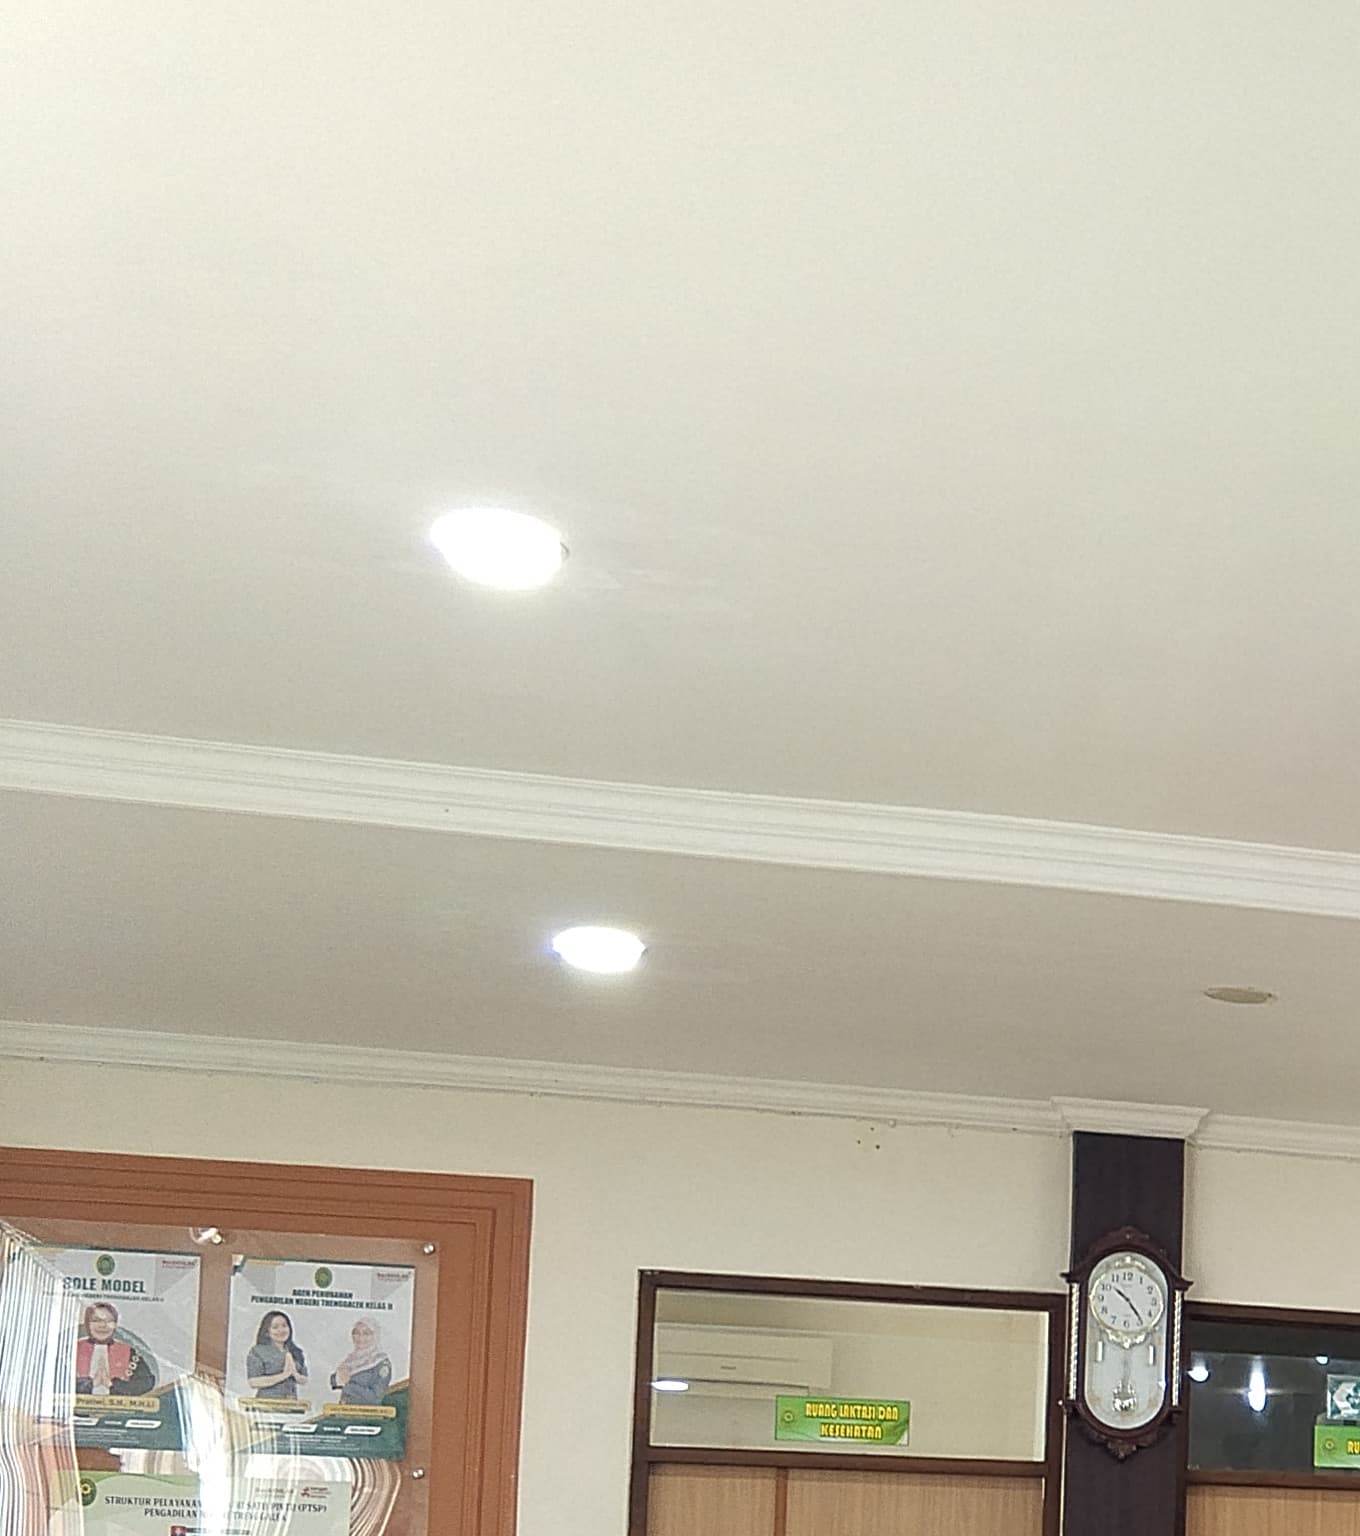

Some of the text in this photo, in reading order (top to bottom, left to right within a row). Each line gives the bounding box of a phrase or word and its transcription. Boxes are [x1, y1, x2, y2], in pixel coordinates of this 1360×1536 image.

[101, 1278, 146, 1293] MODEL
[805, 1403, 899, 1421] RUANG LAKTASI DAN
[820, 1423, 883, 1440] KESEHATAN
[104, 1495, 150, 1506] STRUKTUR
